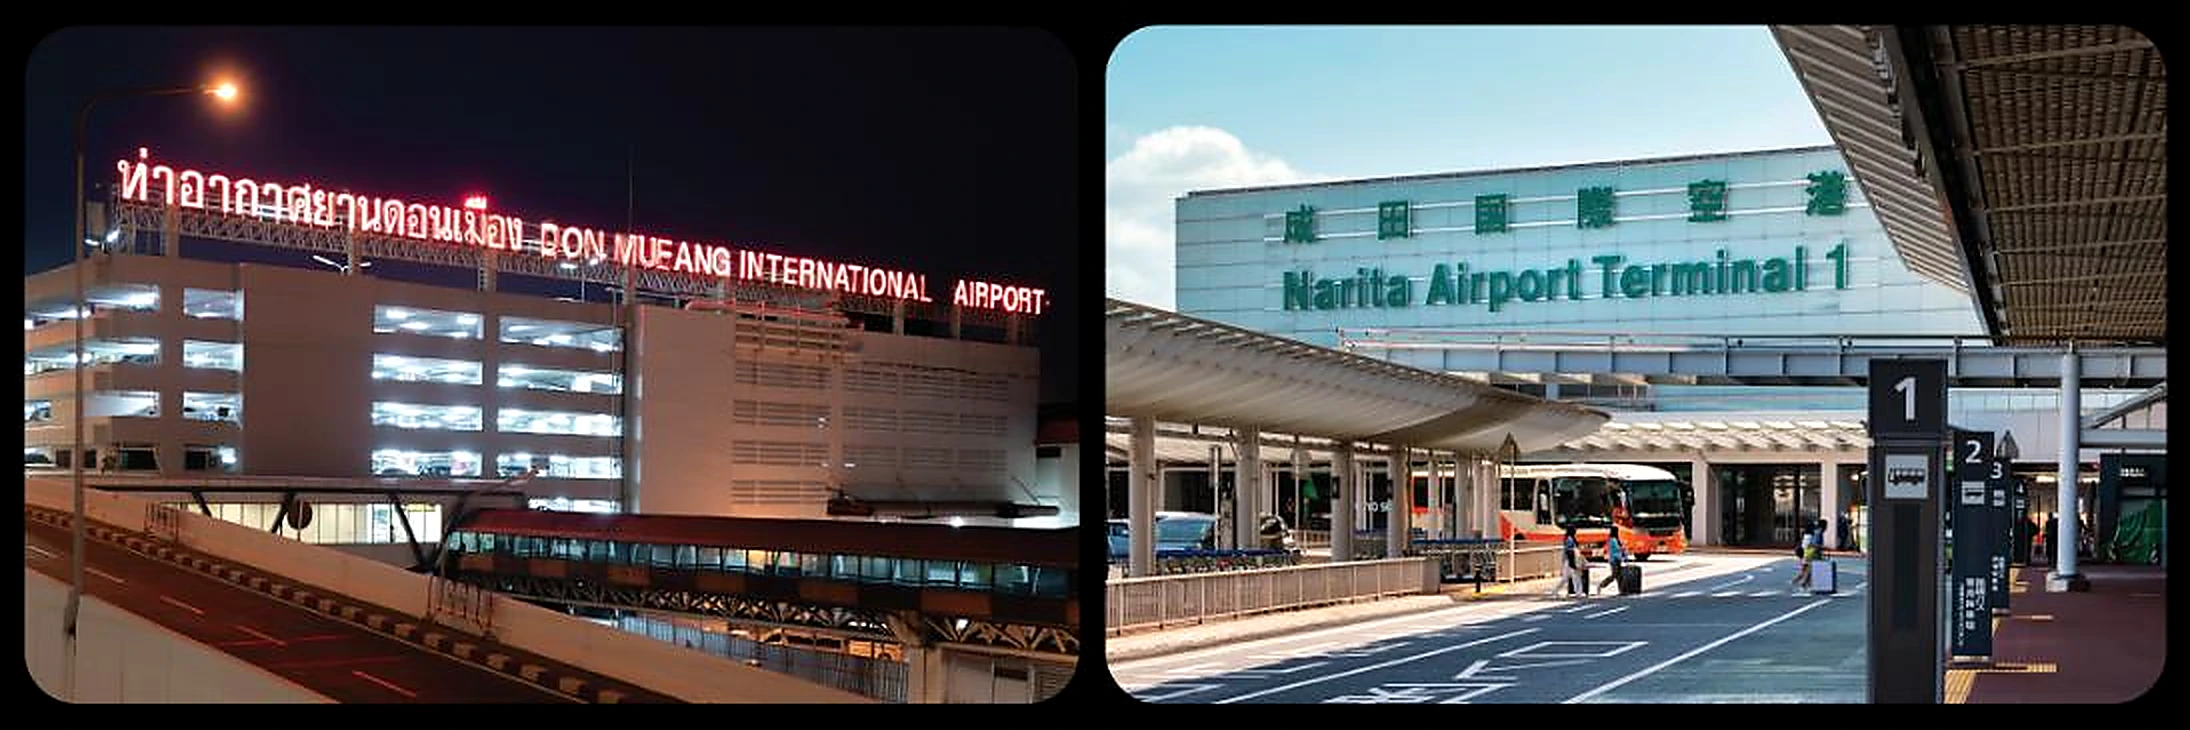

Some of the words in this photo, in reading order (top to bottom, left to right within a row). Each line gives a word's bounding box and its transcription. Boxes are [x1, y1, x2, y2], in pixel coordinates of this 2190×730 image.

[118, 147, 523, 251] ท่าอากาศยานดอนเมือง
[540, 222, 607, 260] DON
[613, 233, 732, 276] MUEANG
[739, 248, 932, 303] INTERNATIONAL
[953, 278, 1044, 315] AIRPORT
[1283, 267, 1411, 311] Narita
[1425, 257, 1580, 312] Airport
[1592, 248, 1806, 299] Terminal
[1826, 243, 1848, 291] 1
[1894, 376, 1917, 421] 1
[1965, 440, 1982, 464] 2
[1990, 461, 2003, 479] 3
